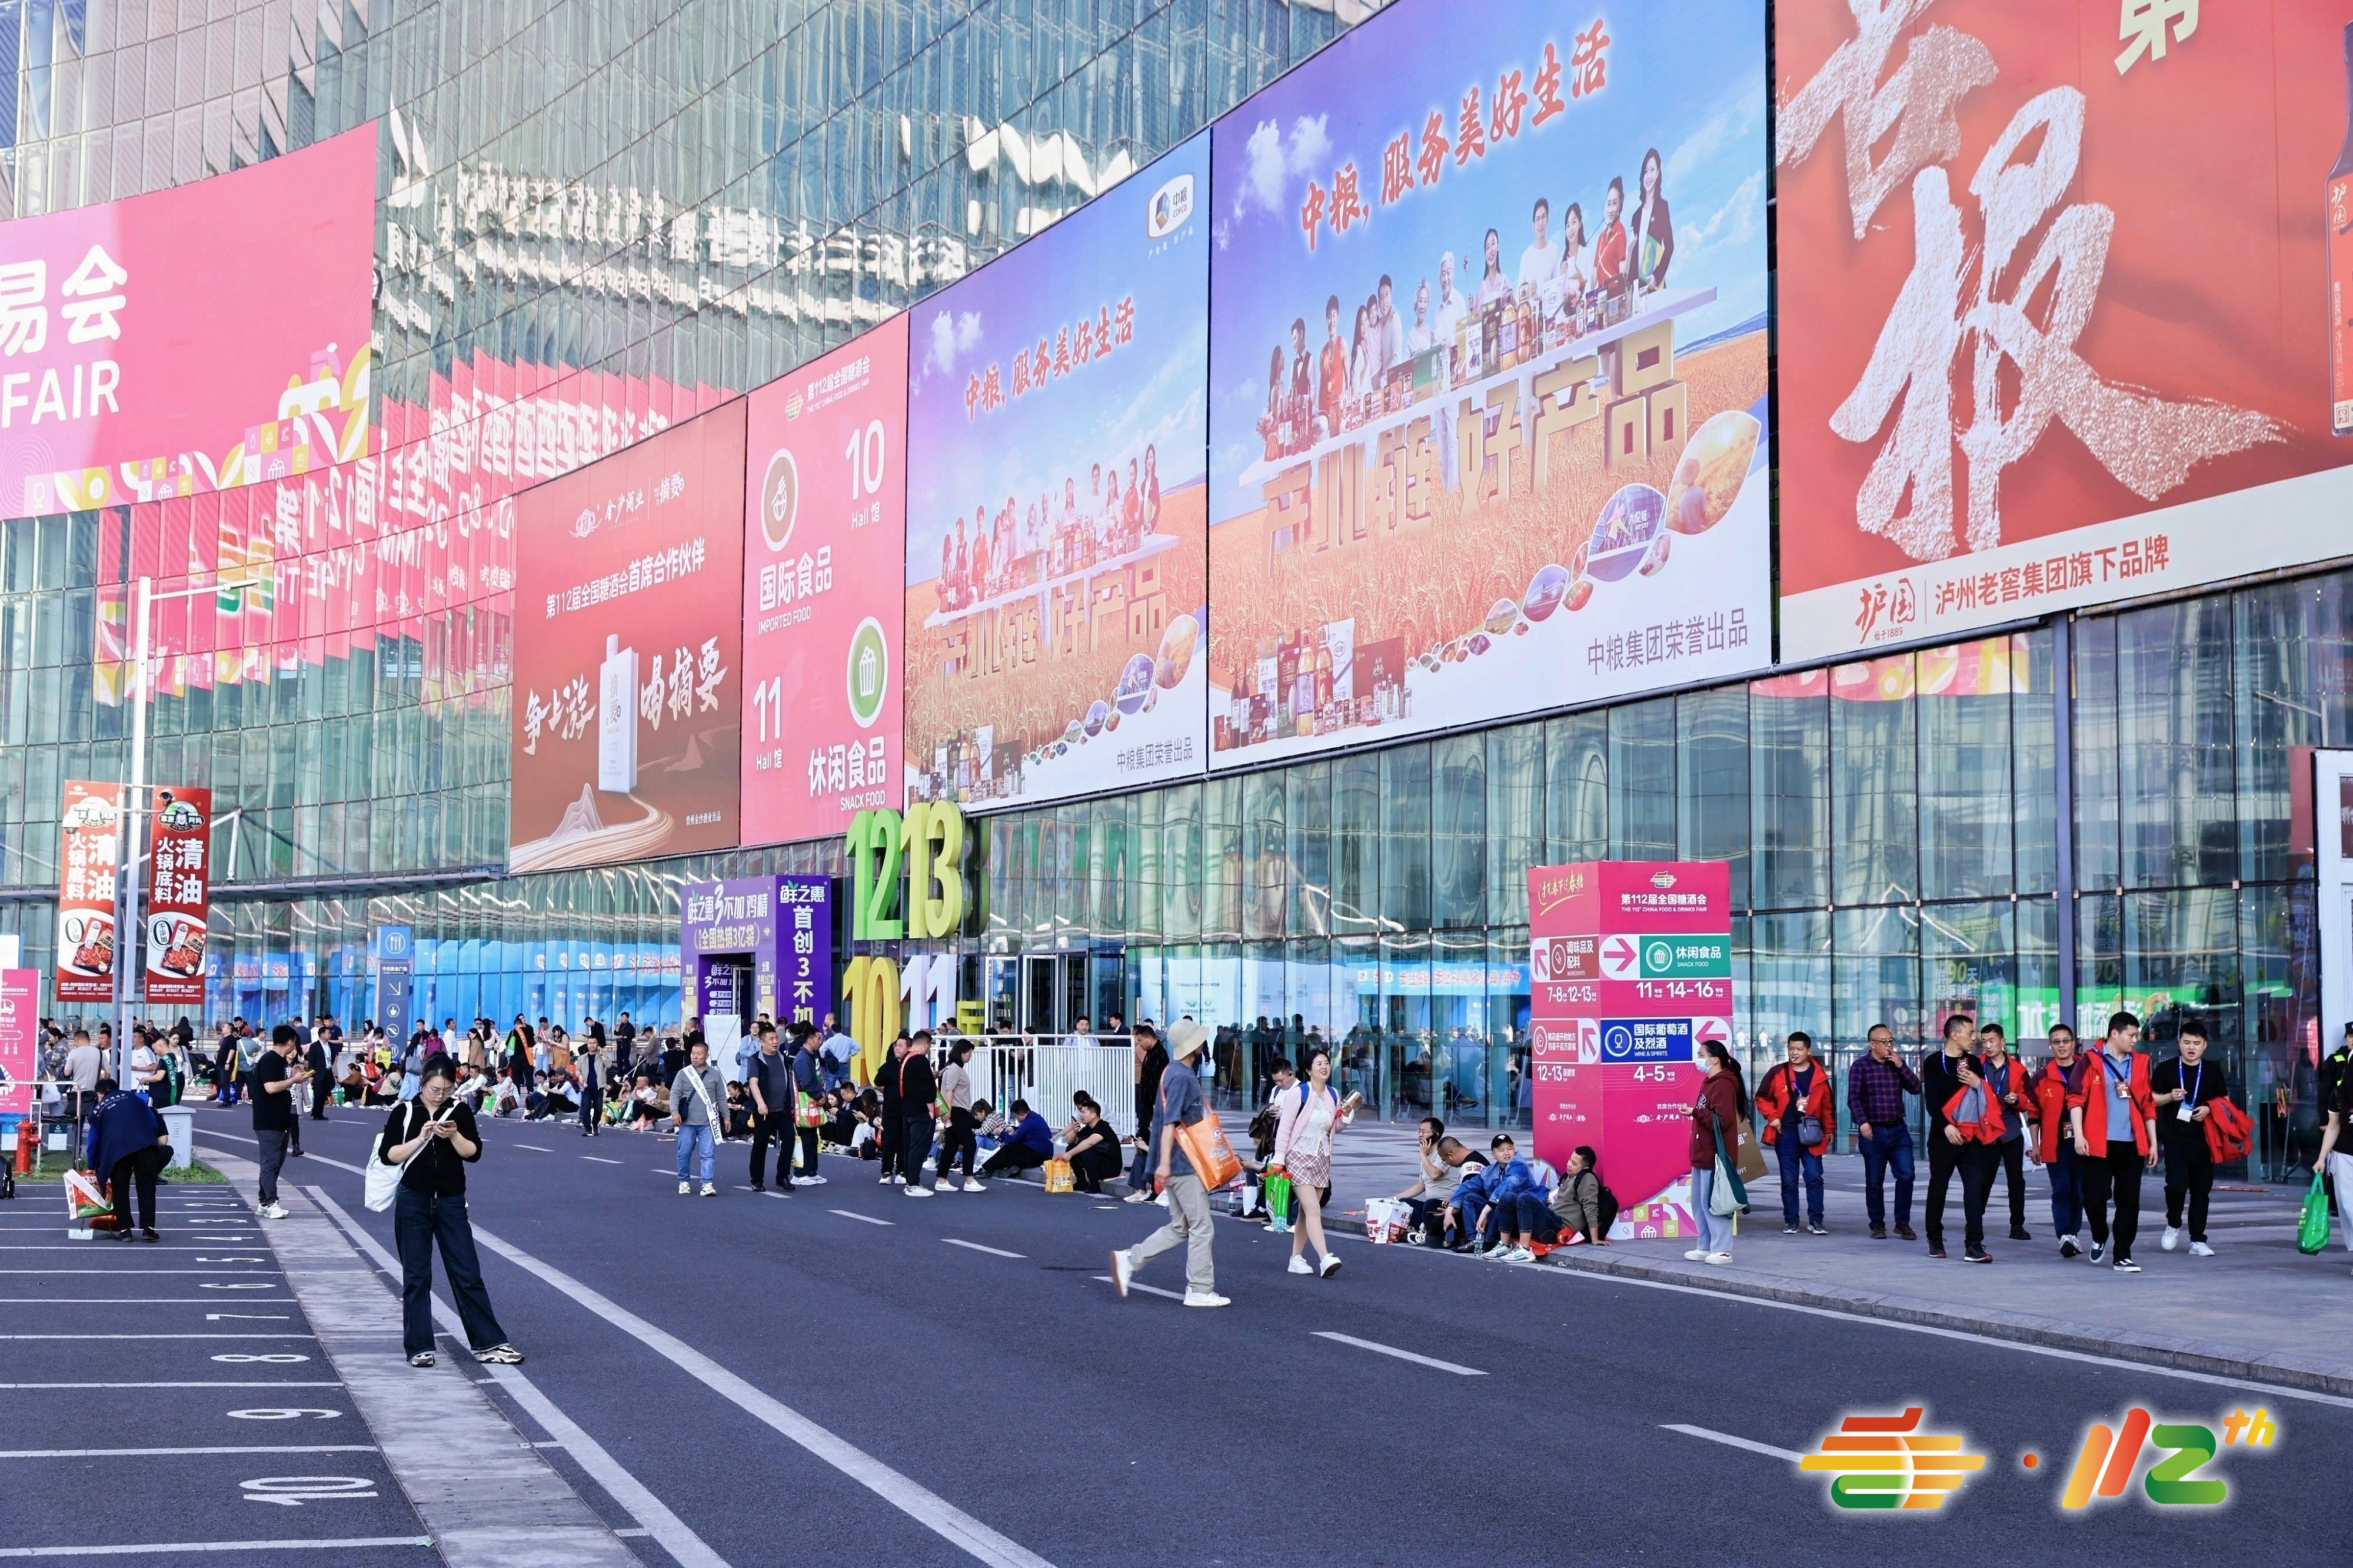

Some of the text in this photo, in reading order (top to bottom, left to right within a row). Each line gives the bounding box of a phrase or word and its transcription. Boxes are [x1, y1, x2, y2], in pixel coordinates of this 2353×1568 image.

[1173, 187, 1187, 207] 中粮
[1173, 204, 1187, 218] COFCO
[807, 355, 870, 402] 第112届全国糖酒会
[2, 359, 120, 428] FAIR
[821, 395, 833, 407] CHINA
[833, 389, 844, 402] FOOD
[847, 381, 861, 395] DRINKS
[861, 377, 870, 389] FAIR
[846, 419, 885, 500] 10
[851, 500, 880, 530] Hall 馆
[546, 536, 705, 620] 第112届全国糖酒会首席合作伙伴
[760, 545, 833, 611] 国际食品
[1855, 534, 2170, 644] 护国 泸州老窖集团旗下品牌
[758, 605, 811, 635] IMPORTED FOOD
[1587, 608, 1749, 677] 中粮集团荣誉出品
[1873, 626, 1903, 642] 始于1889
[522, 673, 597, 755] 争上游
[753, 675, 781, 743] 11
[756, 748, 783, 771] Hall 馆
[808, 735, 886, 798] 休闲食品
[1117, 737, 1193, 774] 中粮集团荣誉出品
[840, 790, 886, 812] SNACK FOOD
[160, 815, 203, 825] 草原 阿妈
[66, 833, 88, 901] 火锅底料
[154, 836, 175, 904] 火锅底料
[175, 838, 204, 905] 清油
[847, 800, 963, 940] 12 13
[745, 893, 768, 919] 鸡精
[780, 883, 825, 904] 鲜之惠
[1620, 893, 1708, 905] 第112届全国糖酒会
[701, 924, 754, 950] 全国热销3亿袋
[1566, 940, 1593, 954] 调味品及
[793, 905, 814, 1025] 首创3不加
[1567, 956, 1580, 970] 配料
[1676, 946, 1722, 960] 休闲食品
[1547, 987, 1562, 1003] 7-8
[1567, 986, 1592, 1002] 12-13
[1636, 982, 1652, 998] 11
[1666, 981, 1713, 998] 14-16
[843, 956, 900, 1087] 10
[900, 954, 957, 1034] 11
[1633, 1023, 1688, 1037] 国际葡萄酒
[1548, 1042, 1576, 1051] 百县千品万家福
[1634, 1037, 1667, 1050] 及烈酒
[1537, 1066, 1576, 1081] 12-13 连接馆
[1633, 1065, 1665, 1081] 4-5
[711, 1118, 720, 1140] Calis
[211, 1354, 311, 1363] 8
[227, 1409, 343, 1420] 9
[238, 1476, 378, 1506] 10
